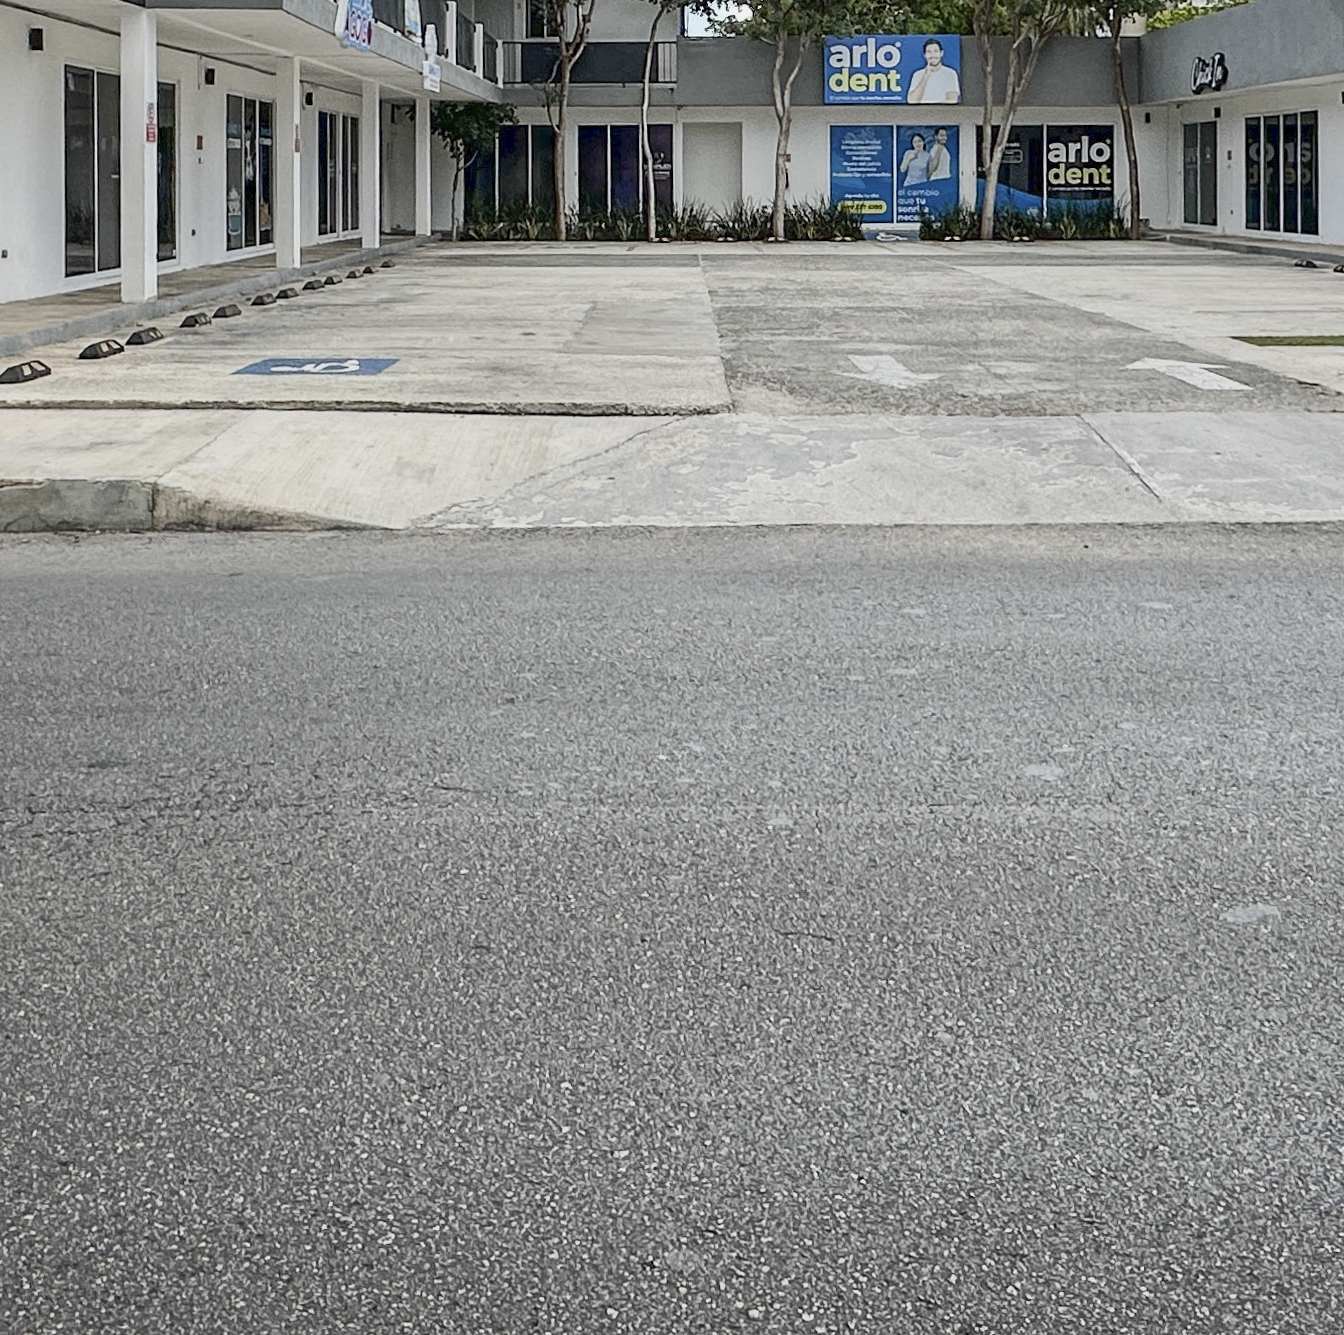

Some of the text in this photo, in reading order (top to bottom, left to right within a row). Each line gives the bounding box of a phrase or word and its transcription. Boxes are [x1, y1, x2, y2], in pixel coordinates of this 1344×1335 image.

[828, 37, 901, 68] arlo
[828, 67, 902, 93] dent
[1047, 135, 1111, 163] arlo
[1047, 163, 1112, 185] dent
[897, 205, 930, 213] sonria
[916, 197, 926, 205] tu
